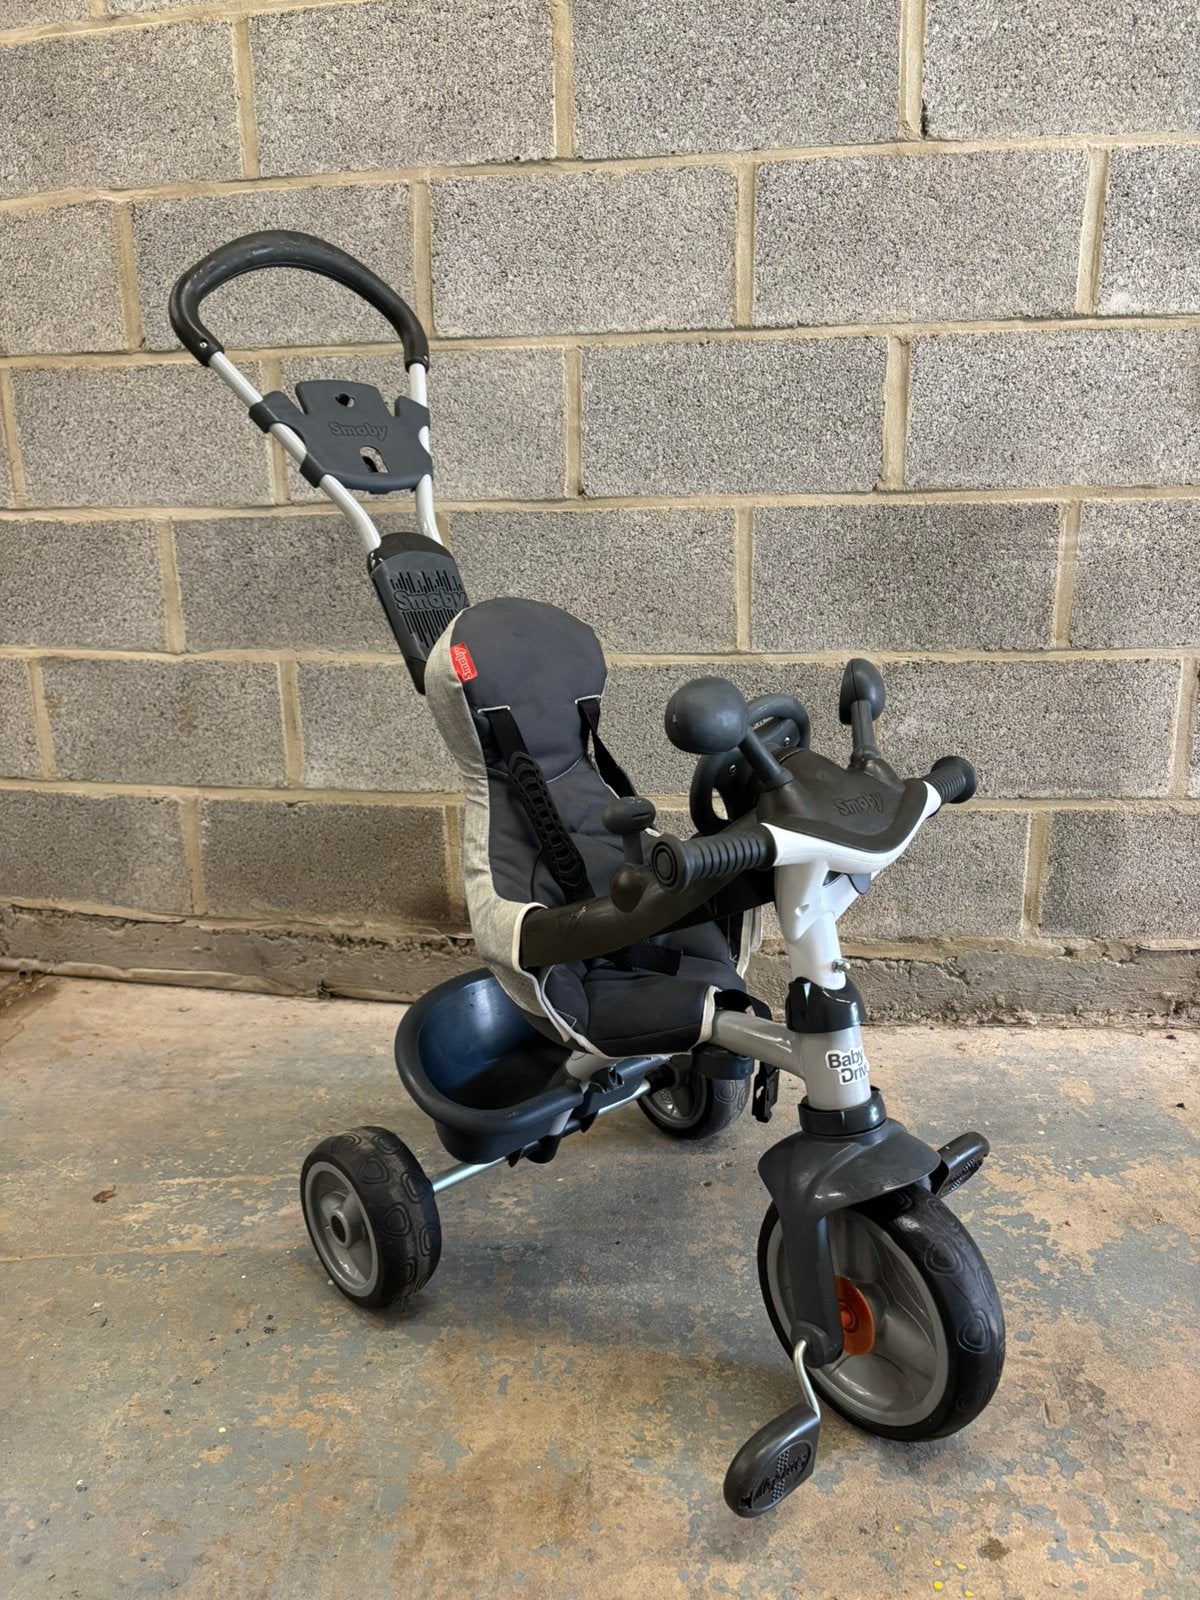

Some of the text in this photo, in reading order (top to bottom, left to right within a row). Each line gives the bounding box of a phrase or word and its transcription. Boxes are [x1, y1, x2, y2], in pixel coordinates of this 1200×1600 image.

[328, 422, 387, 441] Smoby
[394, 588, 467, 611] Smoby
[453, 647, 472, 681] Smoby
[833, 791, 884, 816] Smoby
[828, 1049, 863, 1069] Baby
